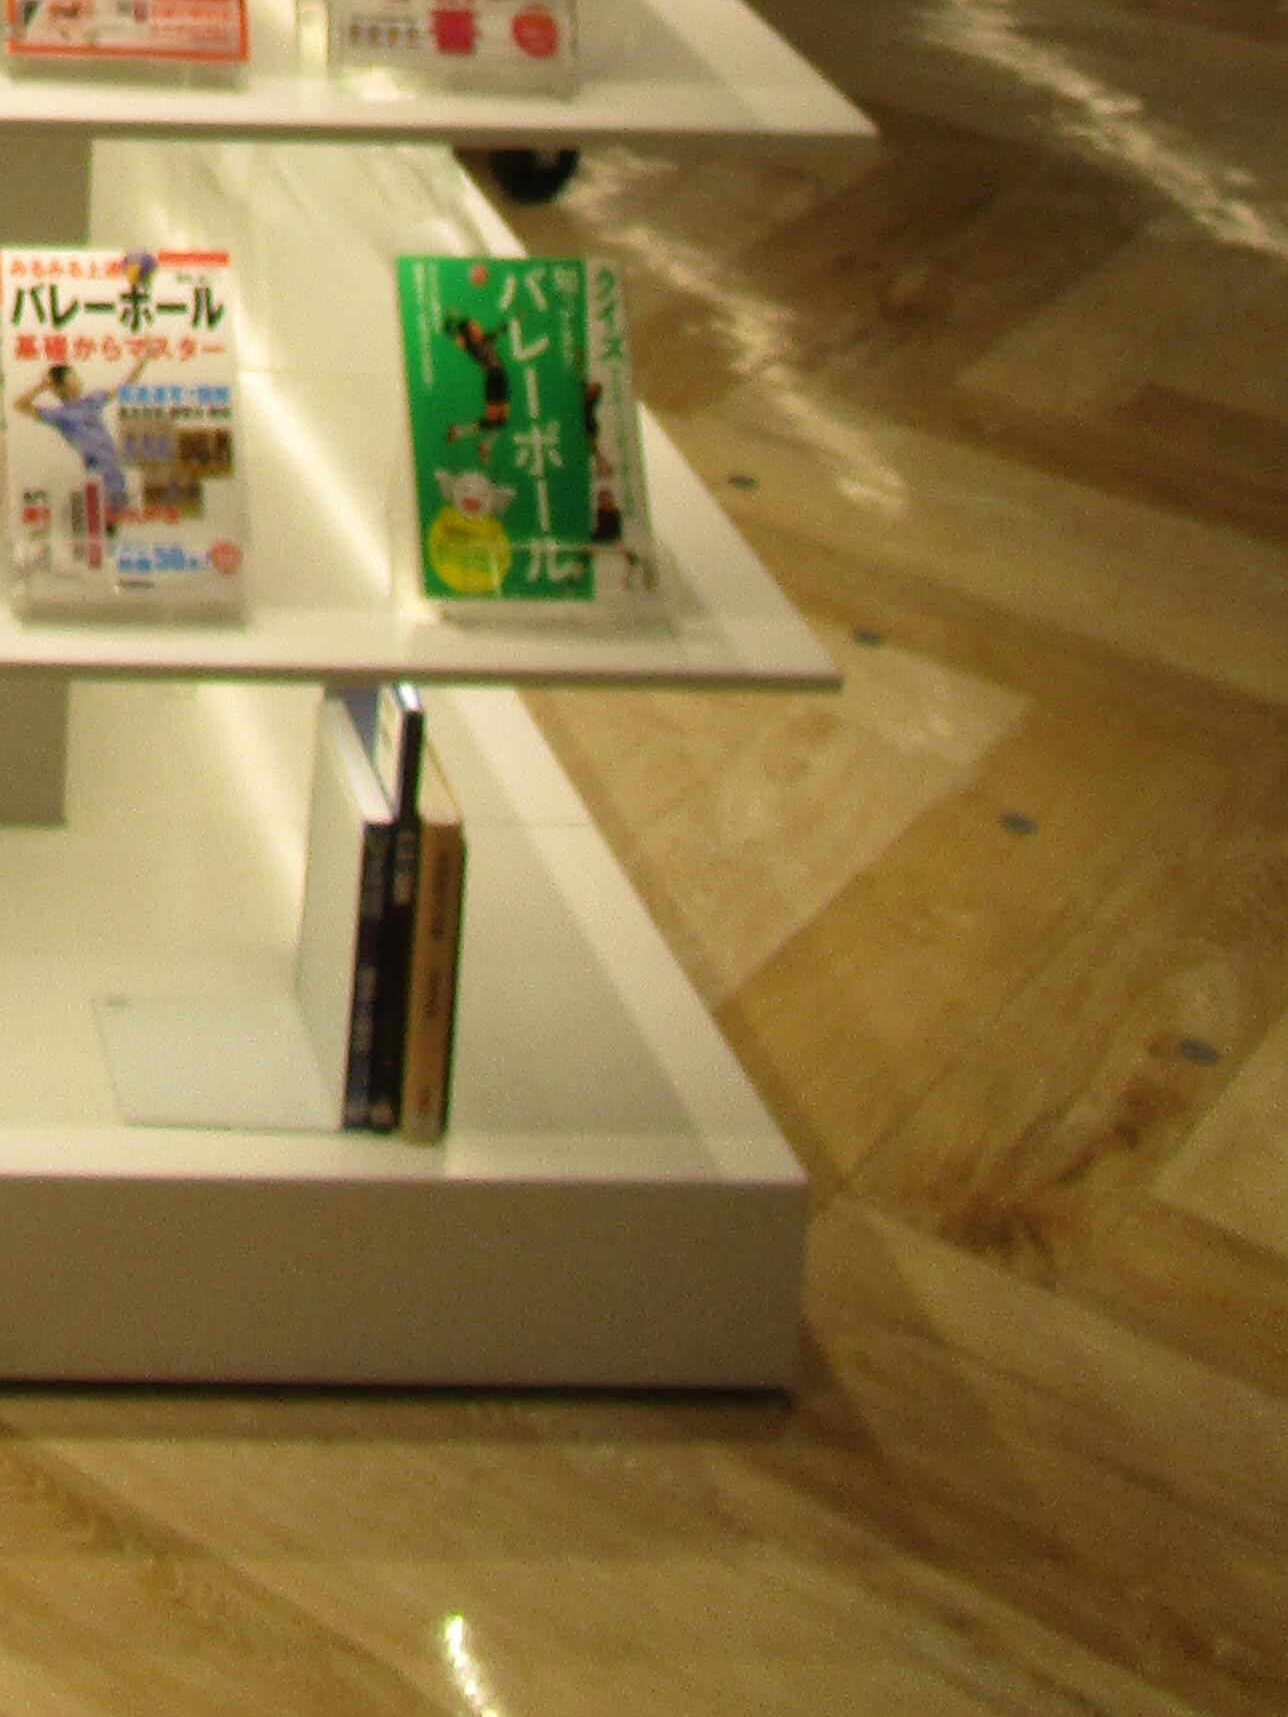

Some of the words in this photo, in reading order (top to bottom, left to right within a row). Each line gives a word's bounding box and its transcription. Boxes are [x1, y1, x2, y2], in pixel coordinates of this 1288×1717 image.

[10, 282, 227, 334] バレーボール
[498, 267, 586, 584] バレーボール
